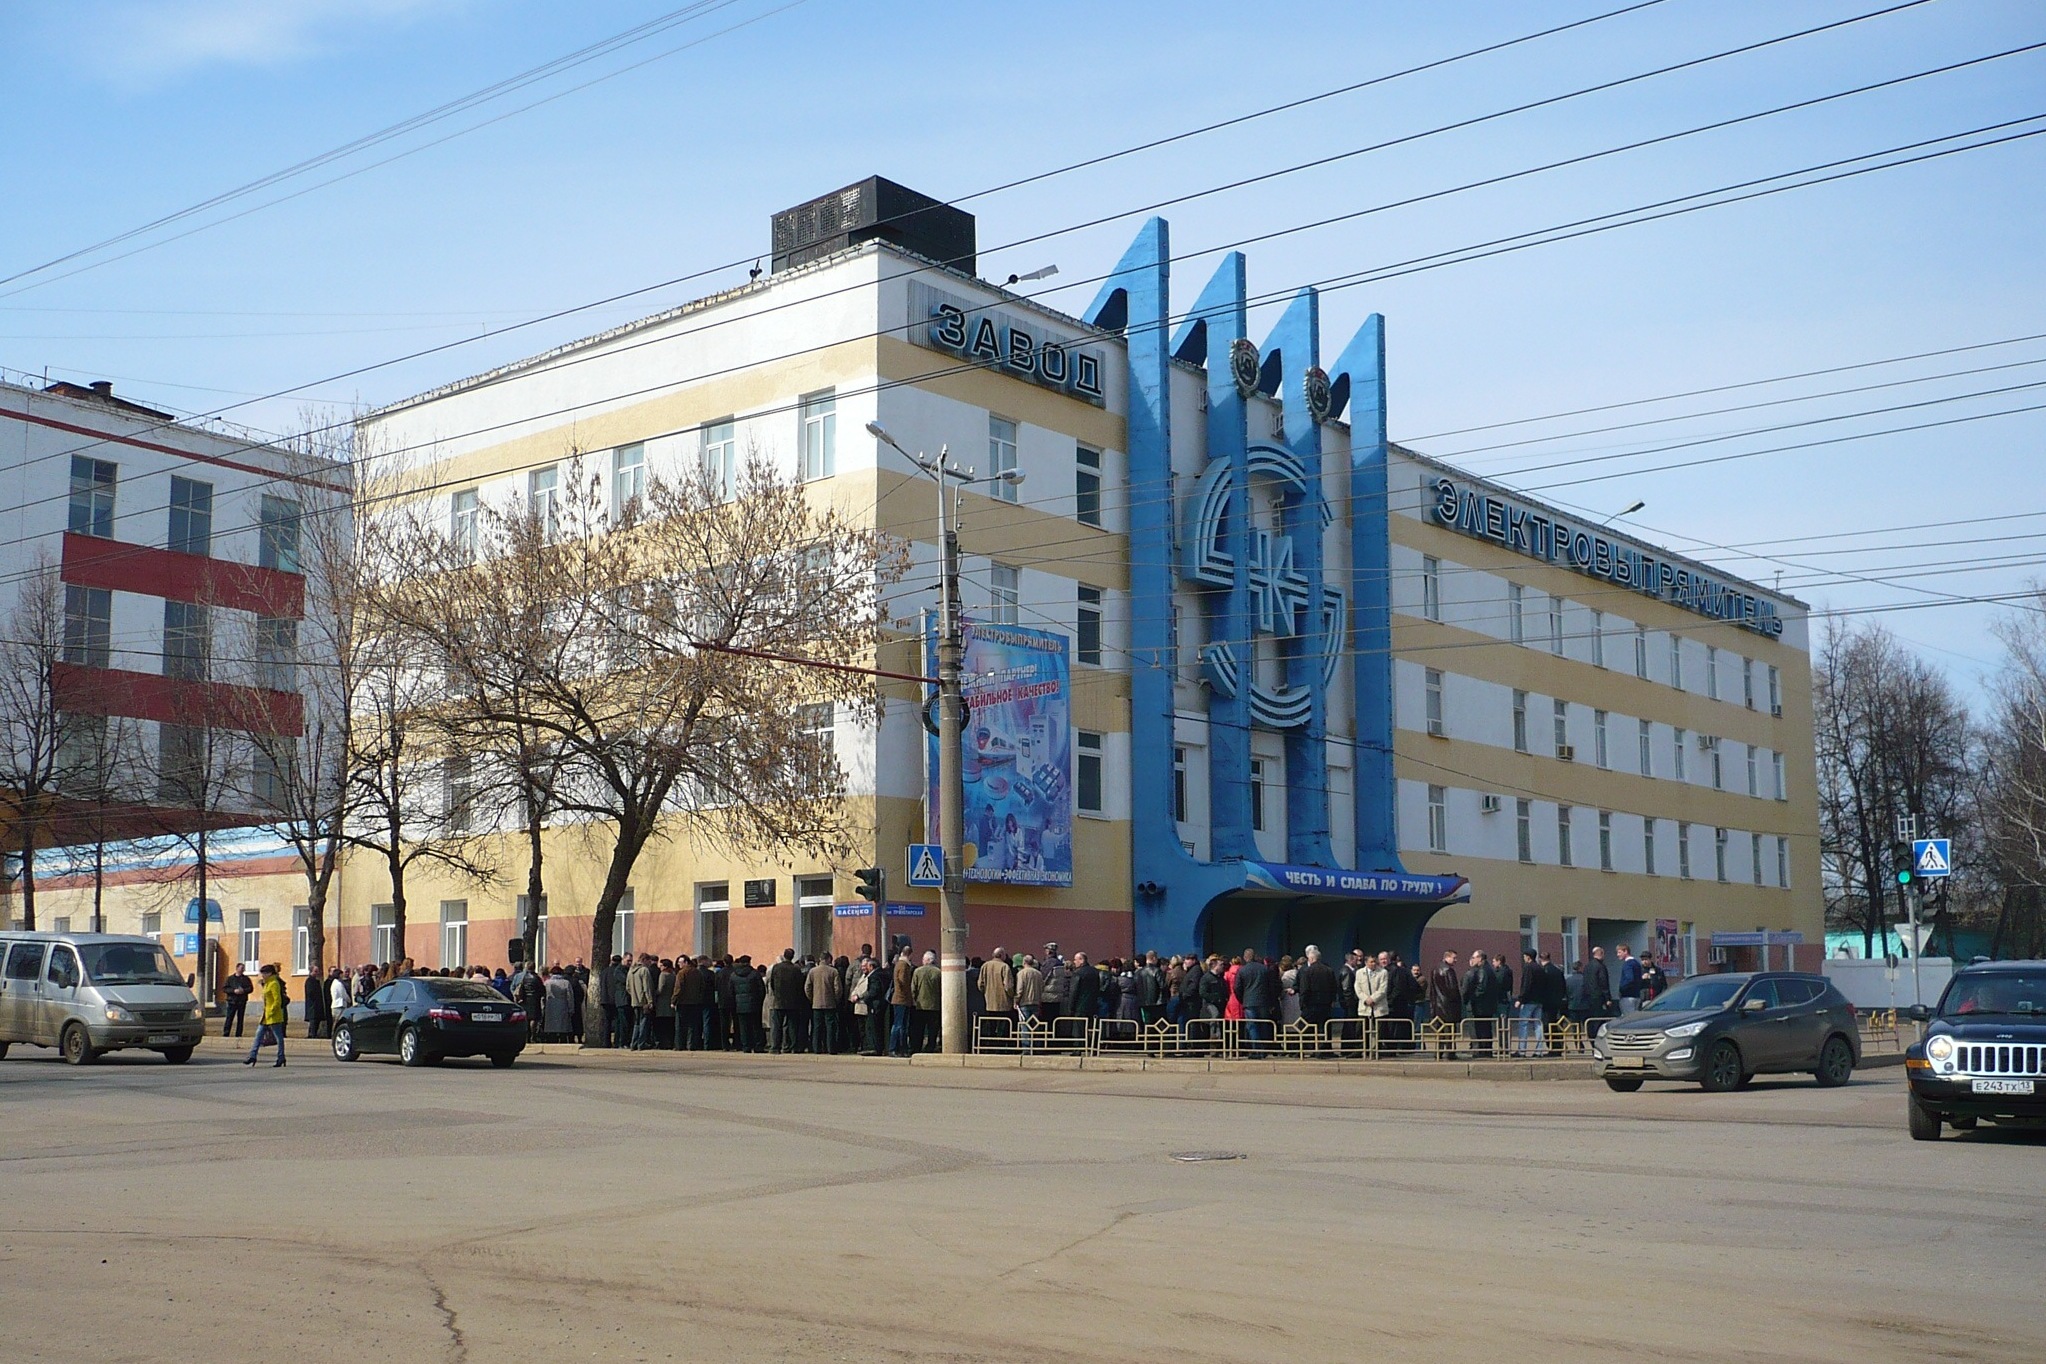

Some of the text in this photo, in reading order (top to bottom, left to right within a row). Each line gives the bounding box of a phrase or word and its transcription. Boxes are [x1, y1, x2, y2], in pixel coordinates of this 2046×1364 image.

[935, 302, 1103, 397] ЗАВОД
[1434, 477, 1785, 637] ЭЛЕКТРОВЫПРЯМИТЕЛЬ
[1018, 680, 1060, 700] КАЧЕСТВО!
[1285, 871, 1322, 886] ЧЕСТЬ
[1326, 875, 1336, 887] И
[1340, 876, 1377, 890] СЛАВА
[1381, 879, 1398, 891] ПО
[1401, 880, 1434, 894] ТРУДУ
